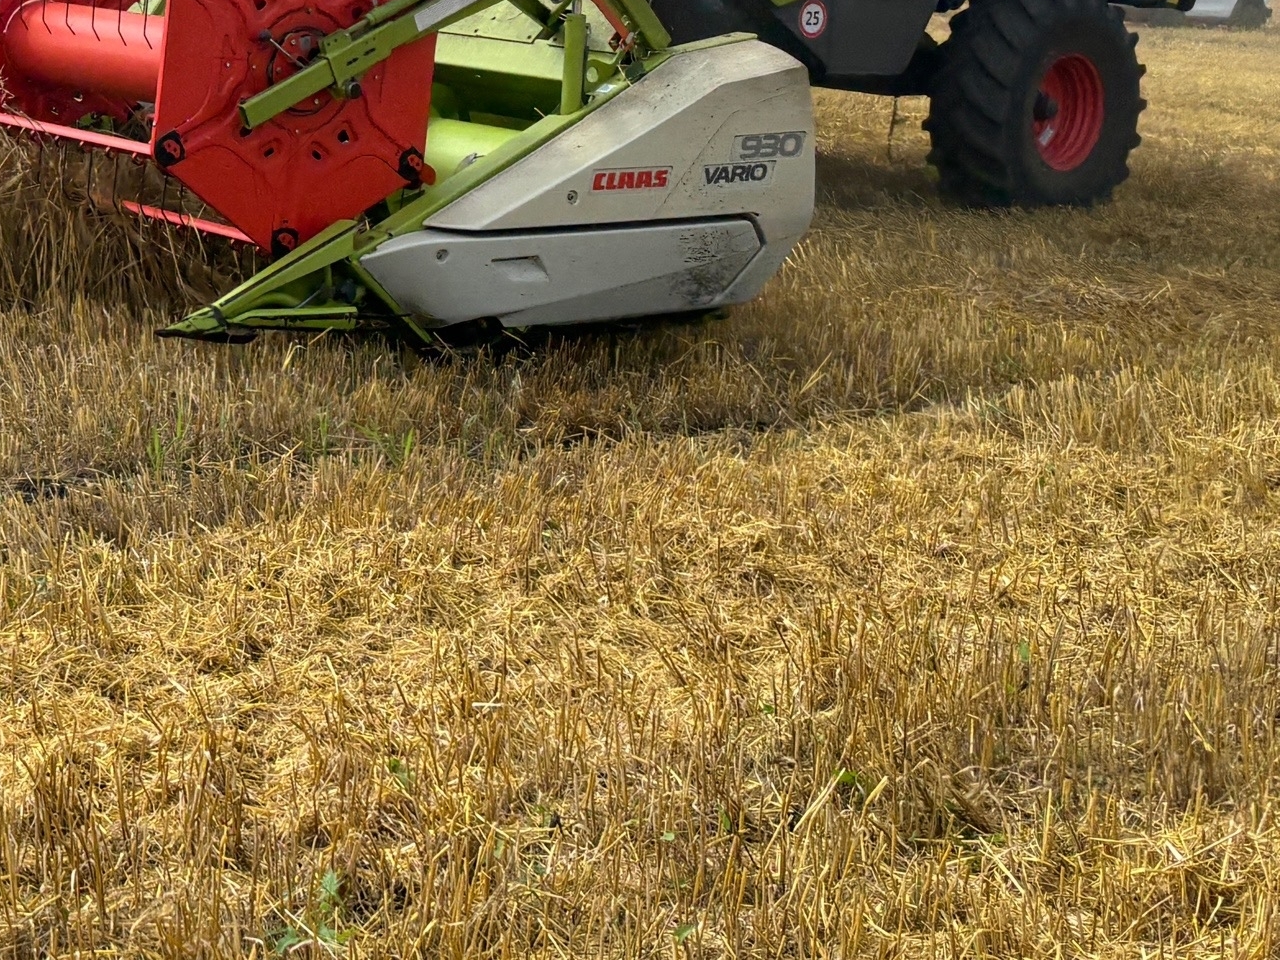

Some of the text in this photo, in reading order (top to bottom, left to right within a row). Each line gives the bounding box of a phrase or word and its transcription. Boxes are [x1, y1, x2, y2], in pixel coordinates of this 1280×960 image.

[805, 10, 820, 26] 25
[740, 132, 804, 159] 930
[592, 169, 669, 191] CLAAS
[704, 163, 768, 185] VARIO
